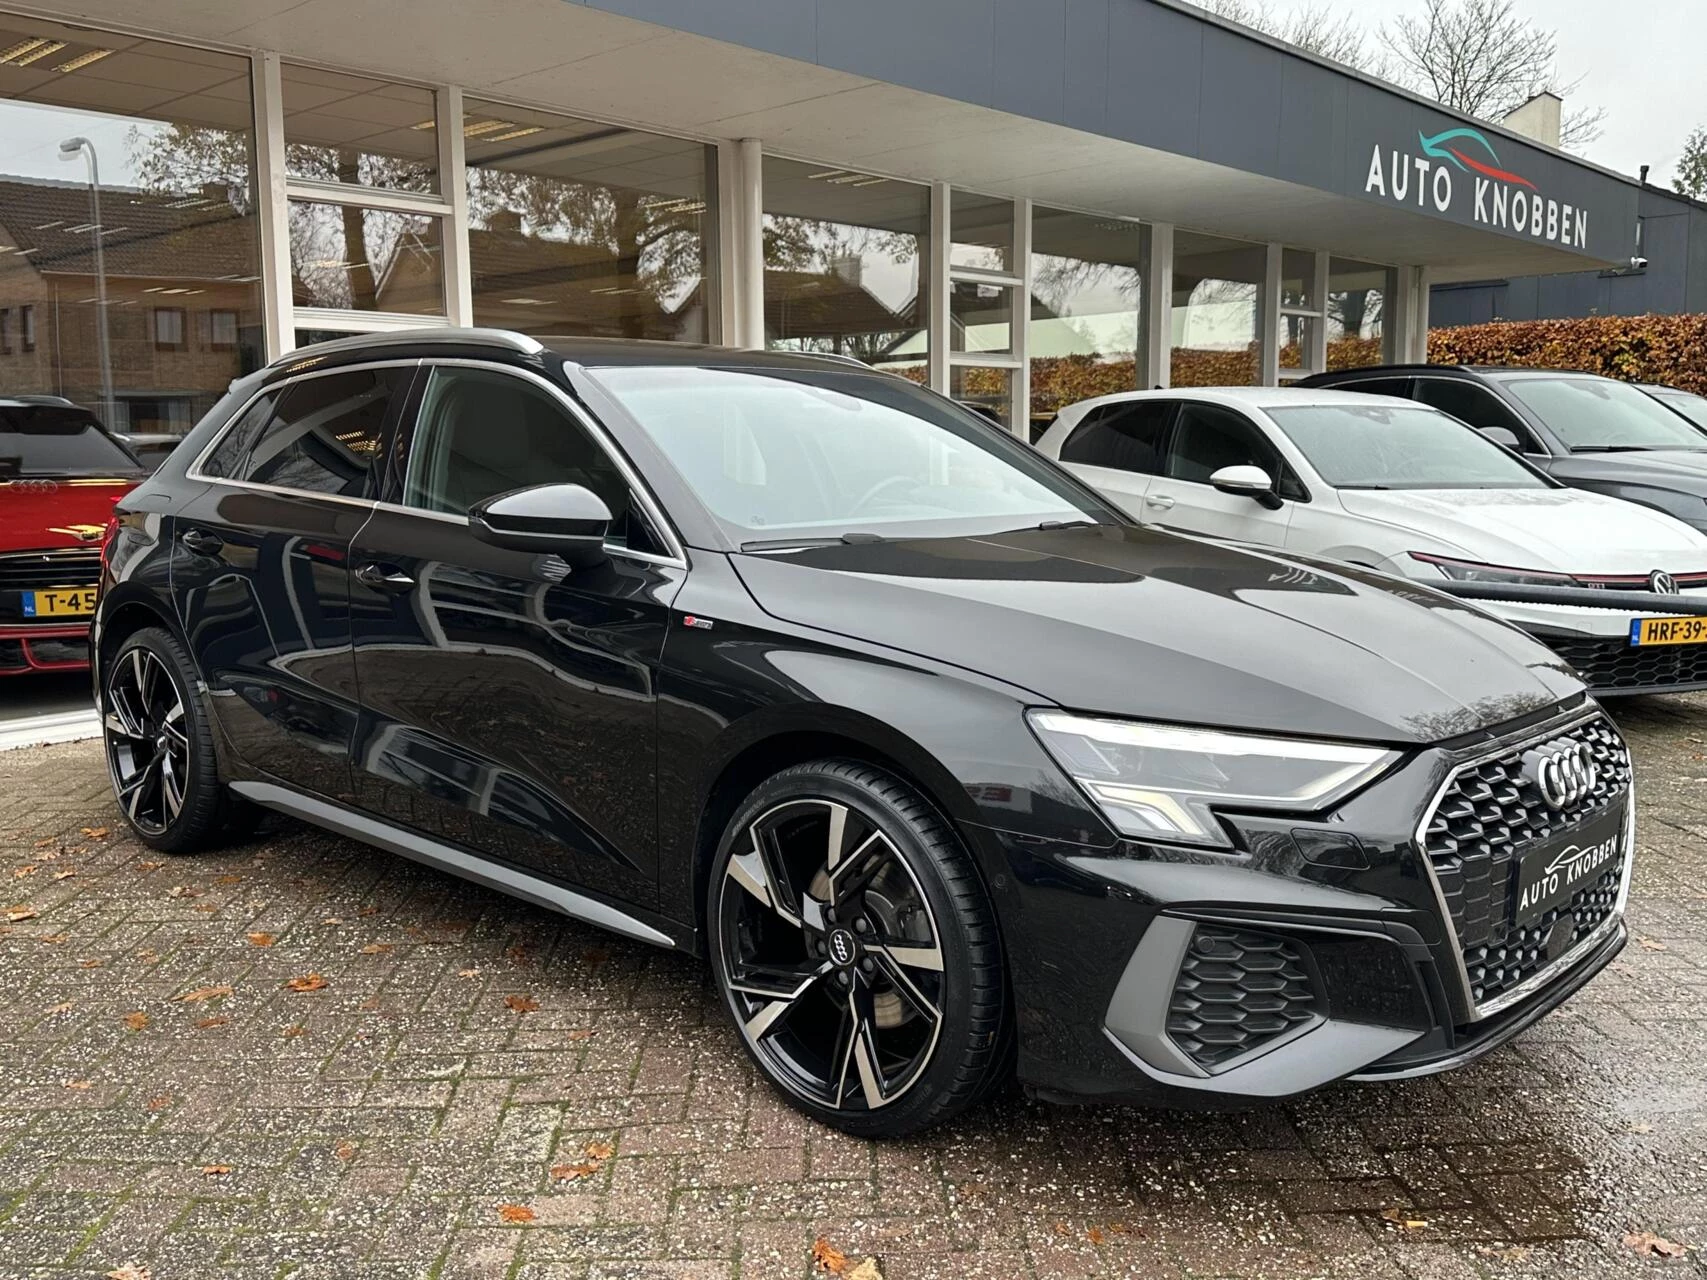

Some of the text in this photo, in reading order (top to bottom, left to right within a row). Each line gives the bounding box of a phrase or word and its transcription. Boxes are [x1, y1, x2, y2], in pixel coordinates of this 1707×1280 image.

[1365, 144, 1587, 249] AUTO KNOBBEN
[1648, 620, 1707, 642] HRF-39-
[1520, 834, 1617, 911] AUTO KNOBBEN
